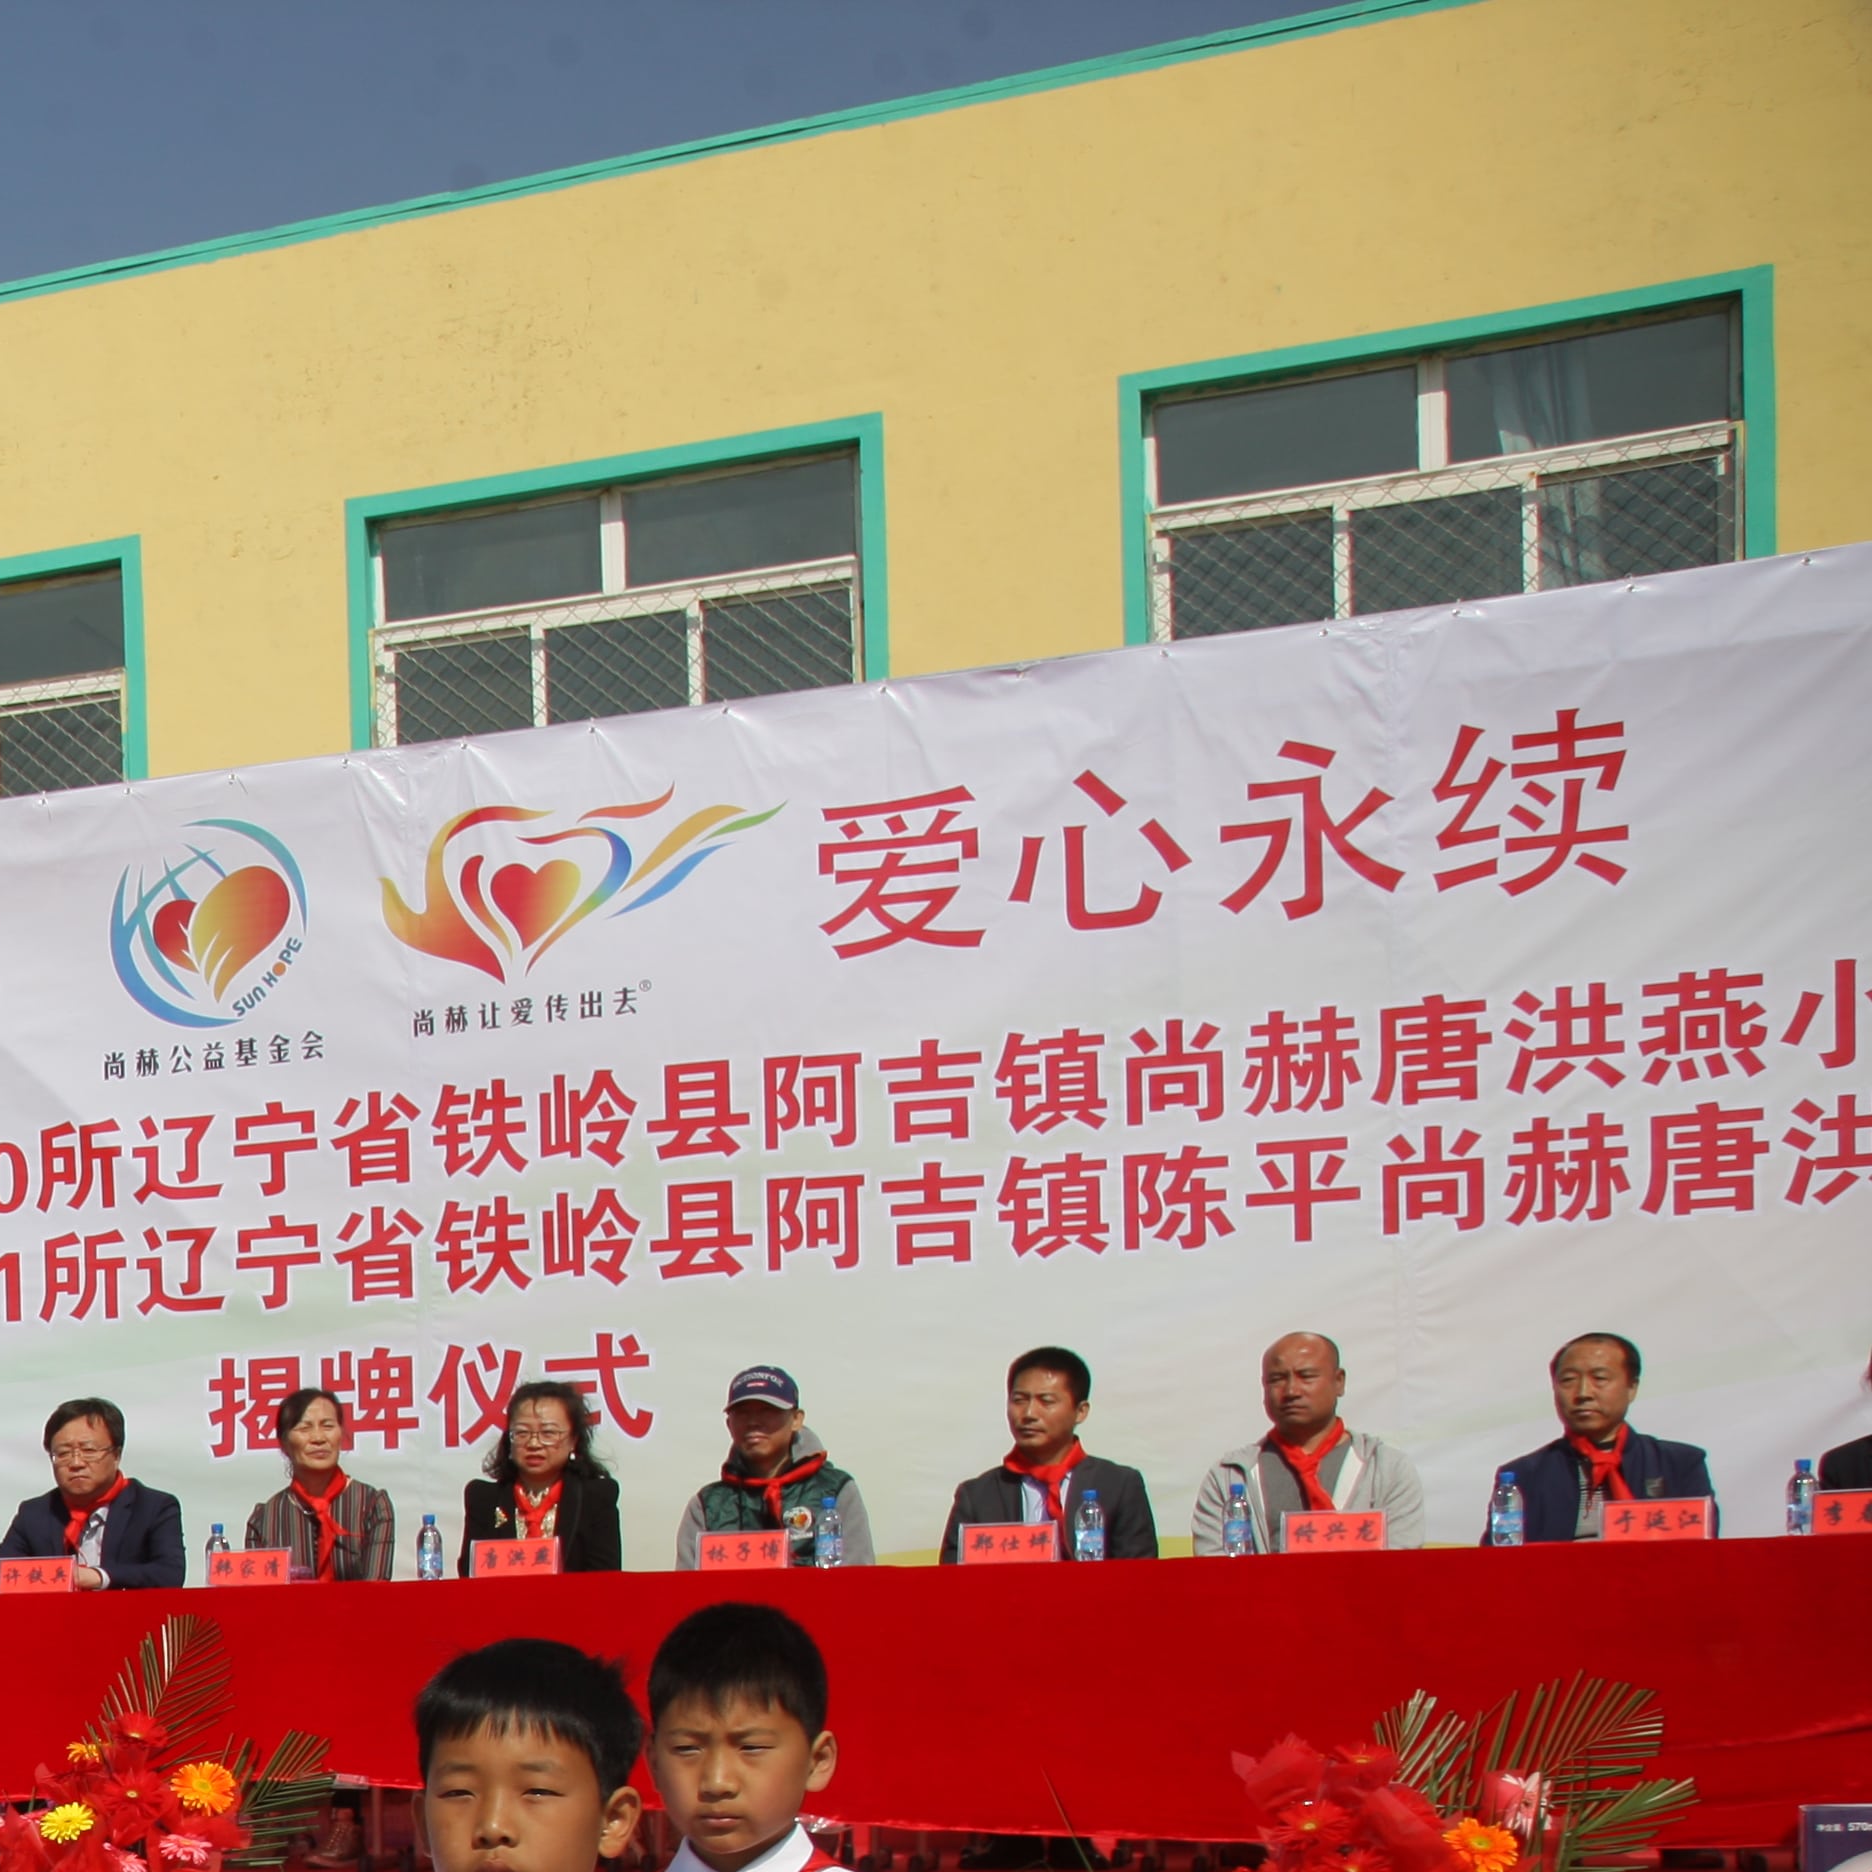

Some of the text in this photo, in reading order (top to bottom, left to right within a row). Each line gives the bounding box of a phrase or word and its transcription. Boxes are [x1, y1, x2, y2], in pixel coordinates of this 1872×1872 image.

[818, 709, 1629, 960] 爱心永续
[232, 985, 267, 1017] SUN
[103, 1030, 324, 1081] 尚赫公益基金会
[207, 1332, 654, 1459] 揭牌仪式
